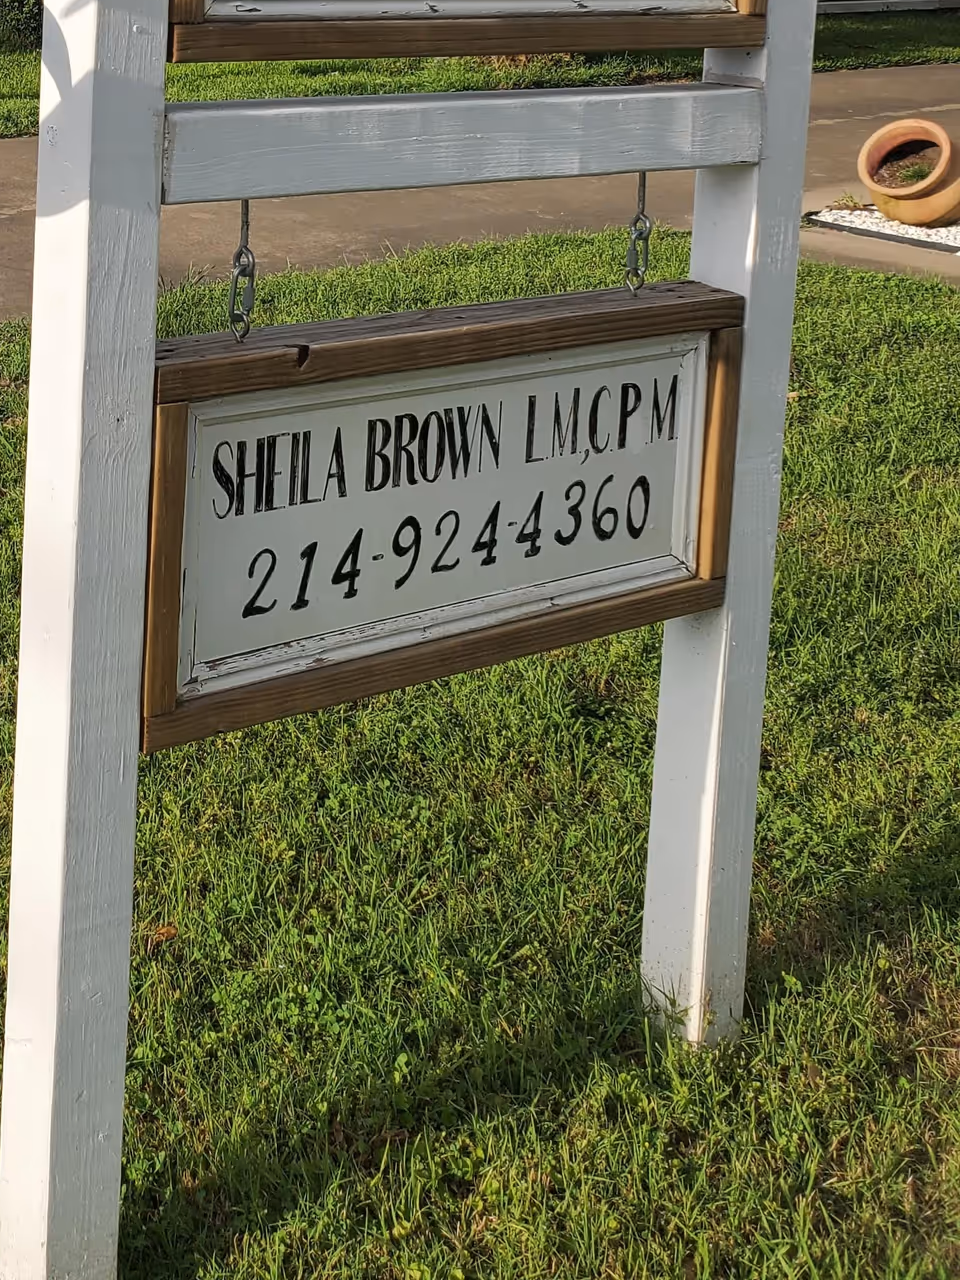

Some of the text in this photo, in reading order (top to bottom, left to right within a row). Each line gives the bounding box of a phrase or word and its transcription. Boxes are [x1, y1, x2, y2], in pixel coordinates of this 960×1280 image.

[211, 426, 349, 520] SHEILA
[364, 400, 504, 493] BROWN
[241, 474, 651, 619] 214-924-4360
